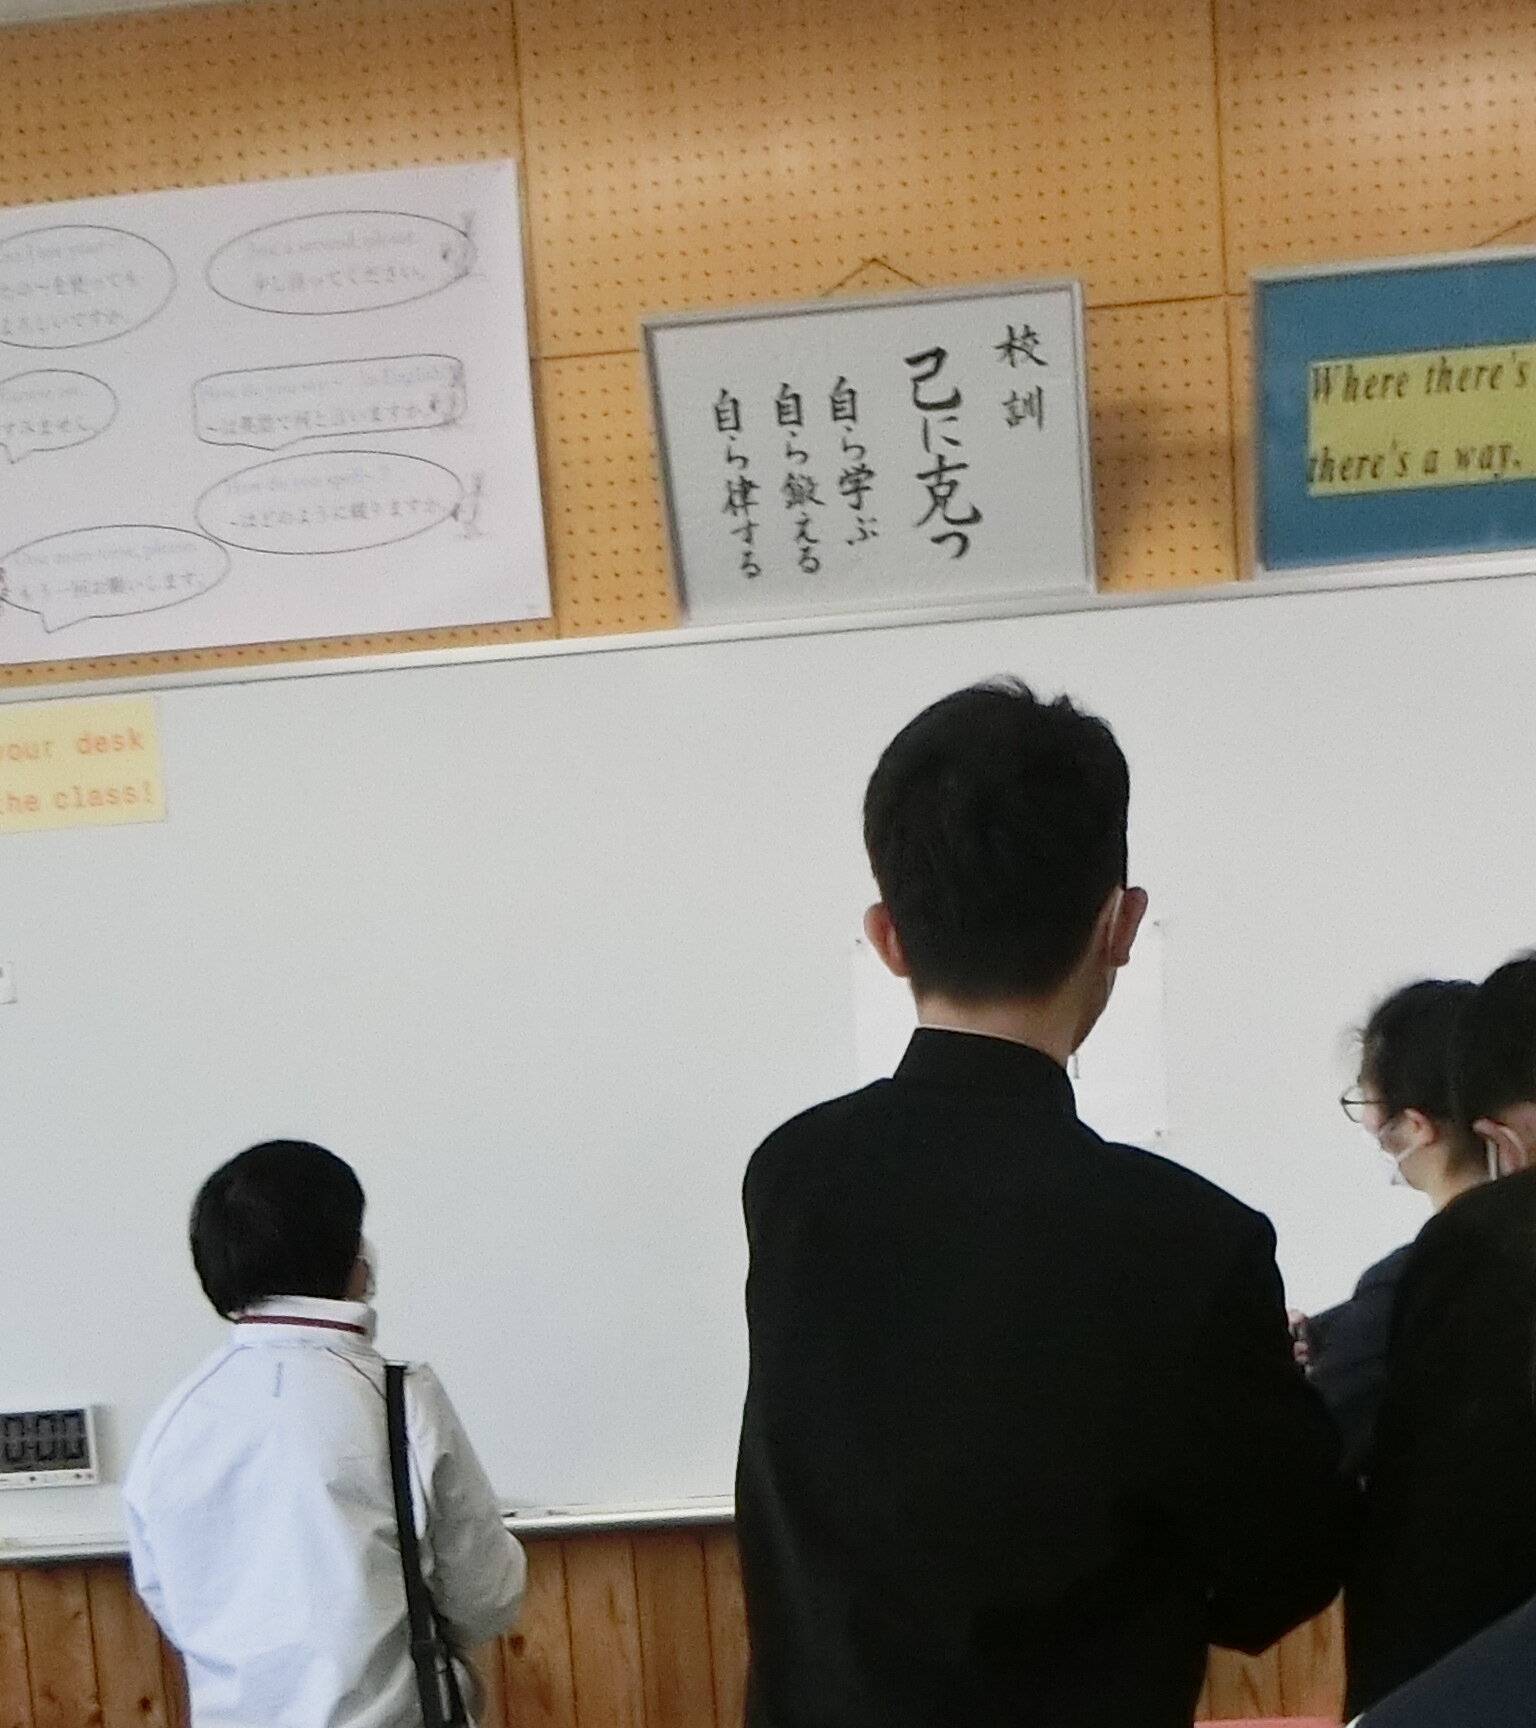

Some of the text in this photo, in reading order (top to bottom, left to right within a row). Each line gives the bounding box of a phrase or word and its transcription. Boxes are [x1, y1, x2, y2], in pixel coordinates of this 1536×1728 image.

[993, 324, 1049, 432] 校訓
[1312, 363, 1410, 403] Where
[1425, 352, 1529, 395] there's
[827, 375, 879, 546] 自ら学ぶ
[904, 346, 984, 562] 己に克つ
[1422, 450, 1441, 475] a
[76, 726, 144, 755] desk
[54, 780, 153, 810] class!
